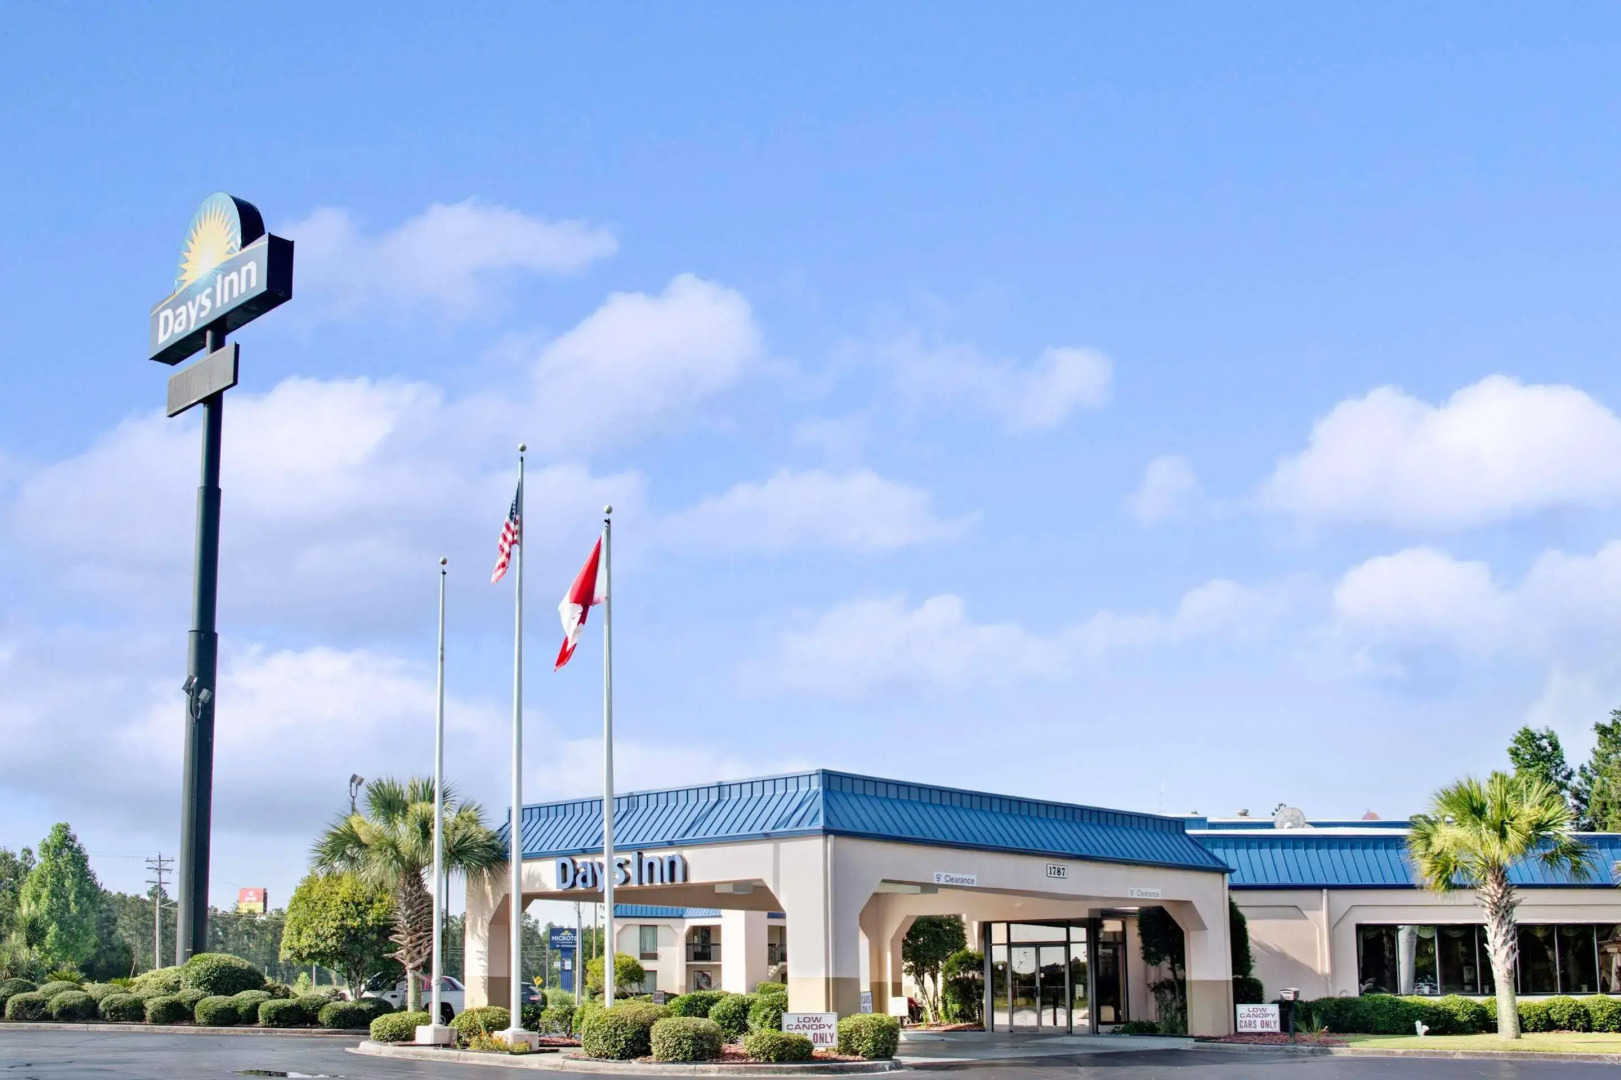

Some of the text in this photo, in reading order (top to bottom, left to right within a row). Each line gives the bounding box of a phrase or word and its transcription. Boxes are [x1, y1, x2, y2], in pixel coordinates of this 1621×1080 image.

[158, 261, 257, 344] Days Inn
[631, 851, 686, 886] Inn
[1048, 866, 1066, 877] 1787
[944, 874, 975, 885] Clearance
[786, 1023, 833, 1031] CANOPY
[1239, 1020, 1277, 1029] CARS ONLY
[812, 1032, 834, 1044] ONLY
